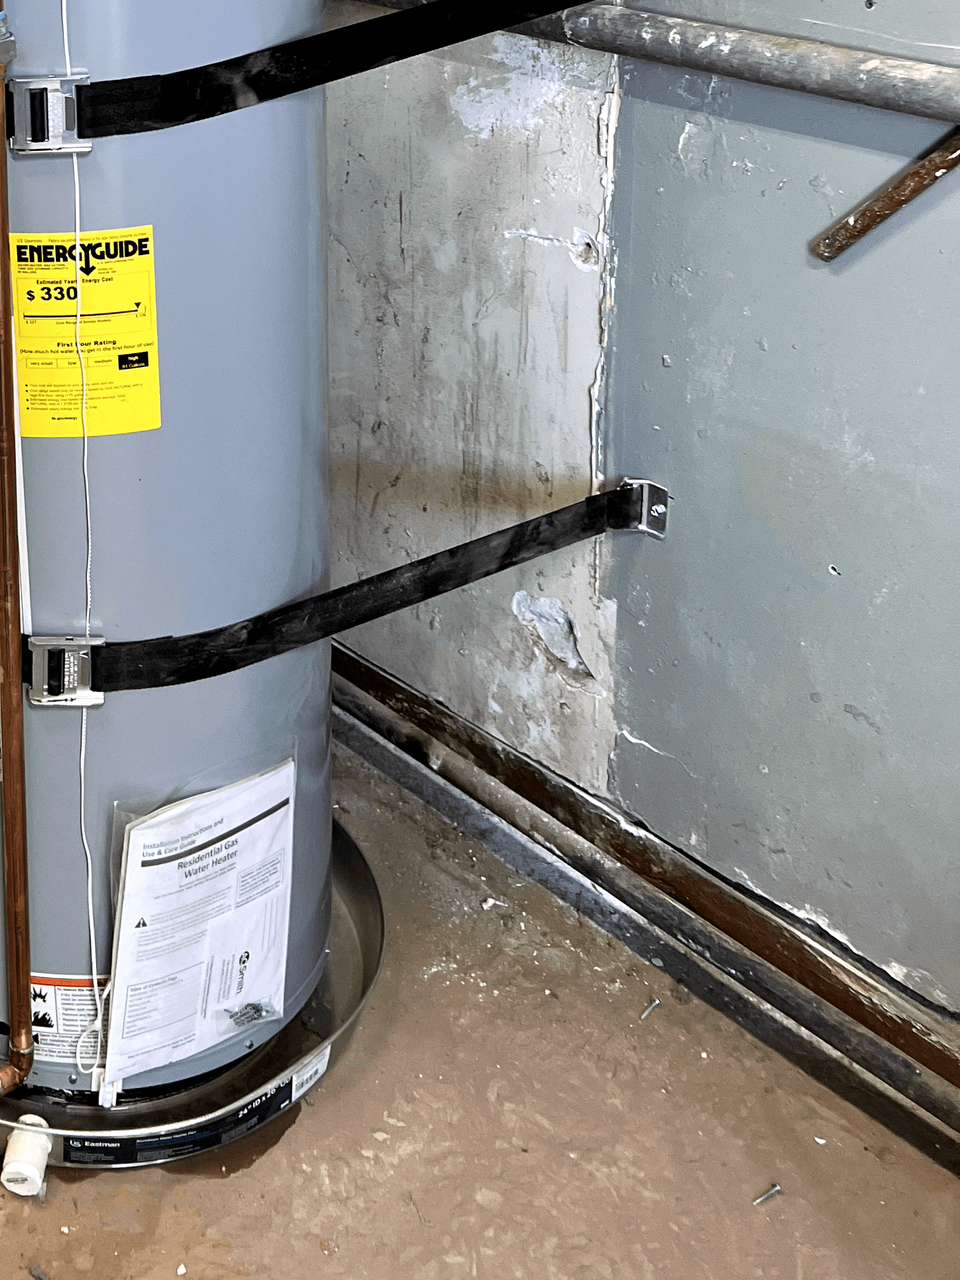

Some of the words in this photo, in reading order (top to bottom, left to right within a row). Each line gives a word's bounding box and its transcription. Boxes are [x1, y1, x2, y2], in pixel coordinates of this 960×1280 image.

[16, 237, 150, 263] ENERGYGUIDE
[41, 286, 78, 300] 330
[143, 838, 179, 850] Installation
[180, 825, 213, 841] Instructions
[213, 817, 224, 827] and
[179, 839, 196, 849] Guide
[177, 845, 223, 870] Residential
[224, 838, 238, 850] Gas
[184, 863, 209, 879] Water
[211, 850, 238, 867] Heater
